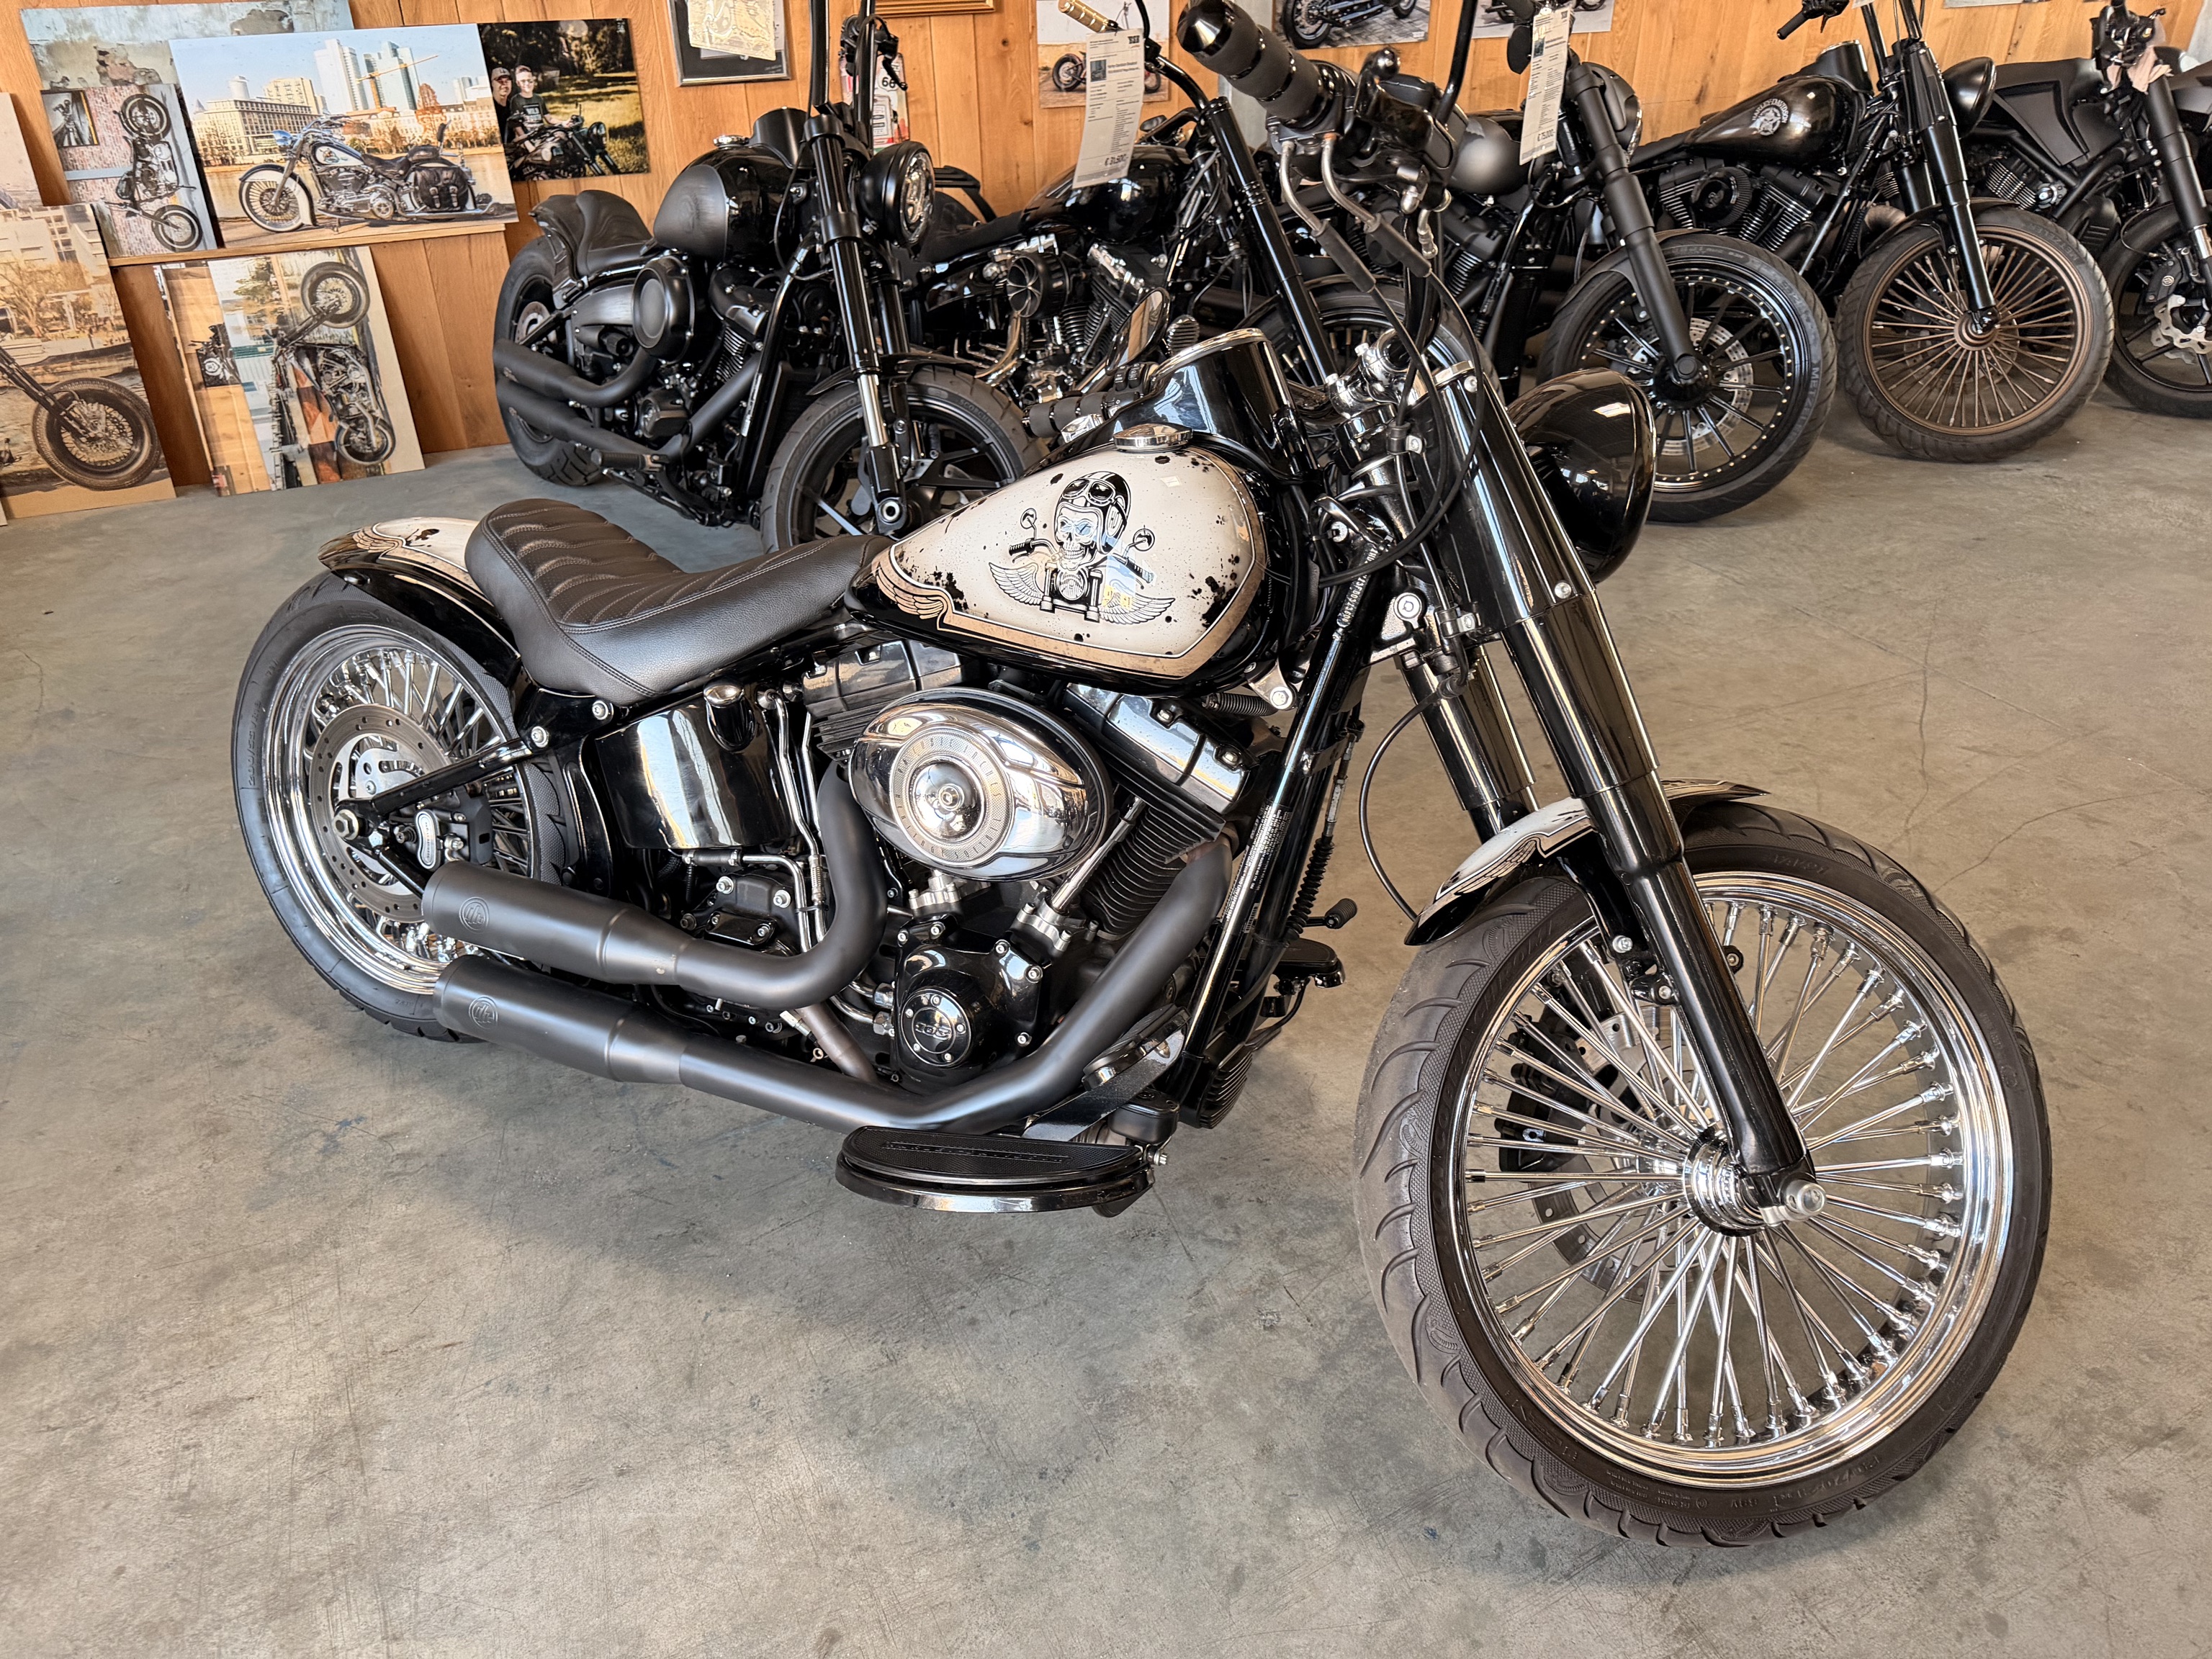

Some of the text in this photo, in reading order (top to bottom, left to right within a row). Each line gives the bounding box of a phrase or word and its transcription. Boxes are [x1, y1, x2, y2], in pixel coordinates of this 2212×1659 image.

[882, 77, 896, 89] 66
[1752, 99, 1789, 124] HARLEY-DAVIDSON
[963, 745, 1002, 797] INCHES
[954, 817, 1002, 859] SOFTAIL
